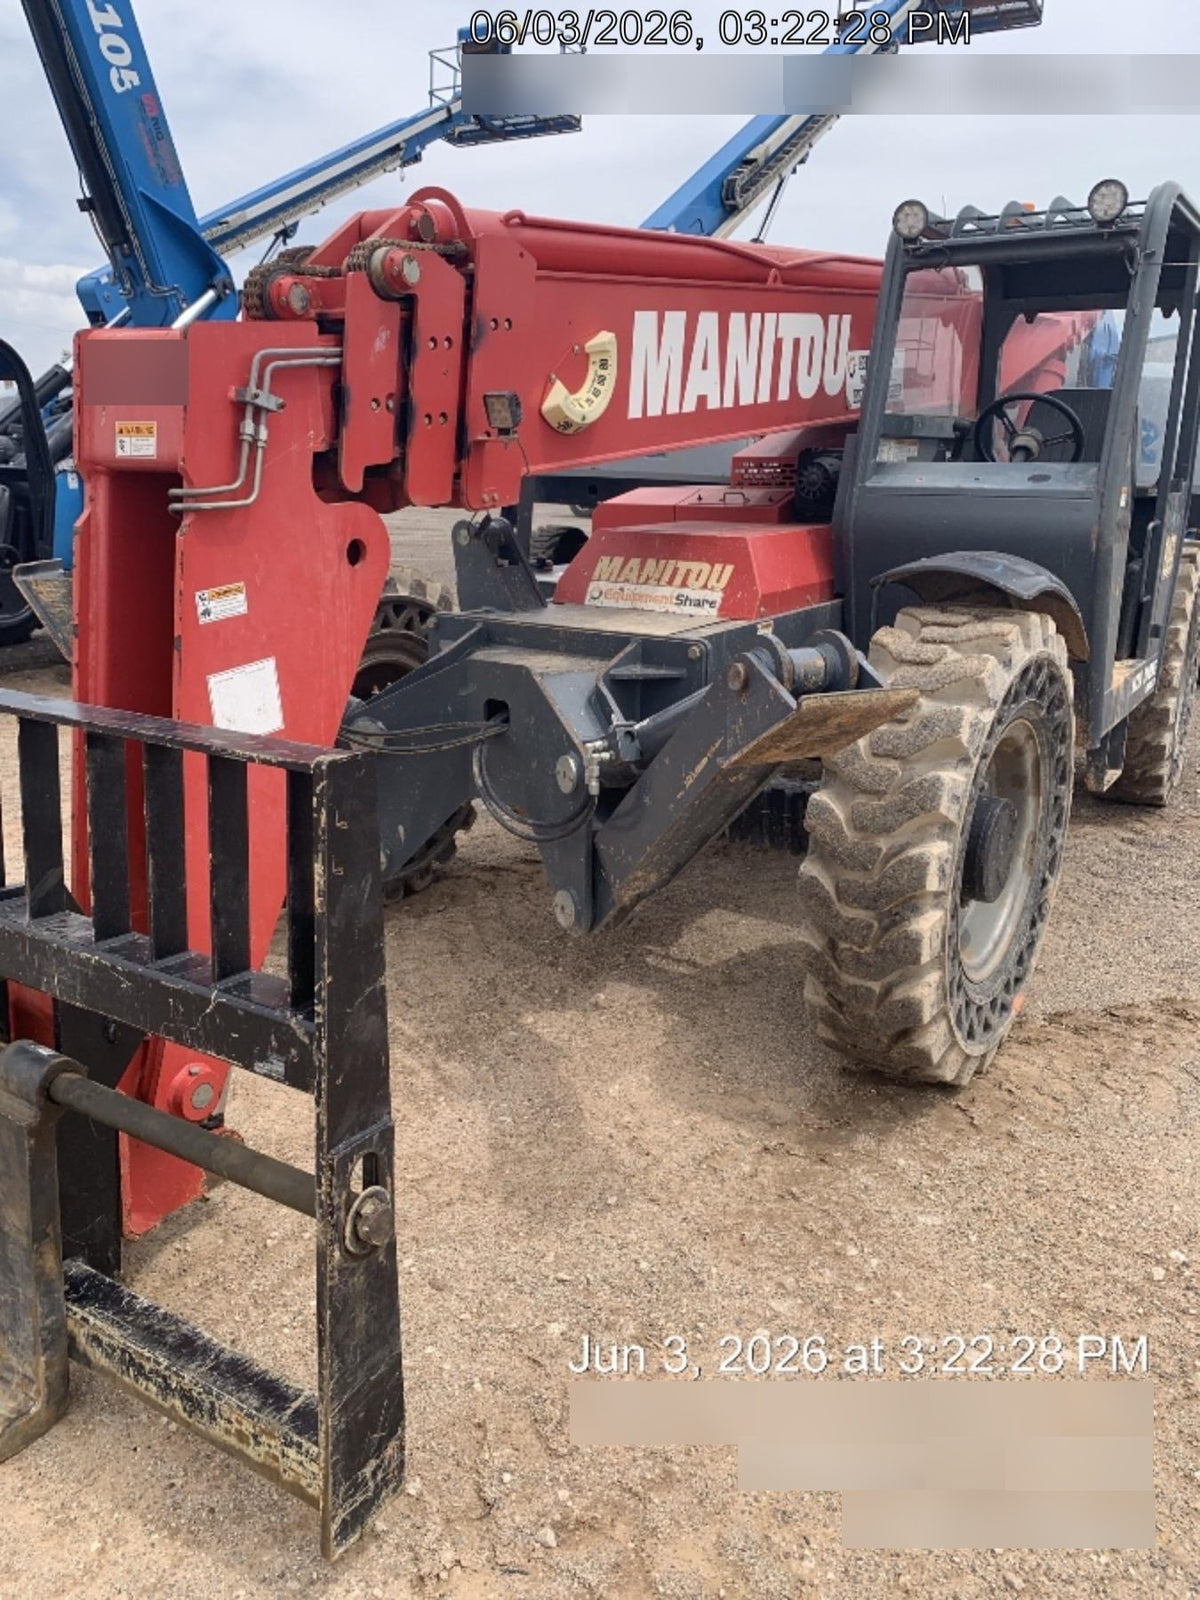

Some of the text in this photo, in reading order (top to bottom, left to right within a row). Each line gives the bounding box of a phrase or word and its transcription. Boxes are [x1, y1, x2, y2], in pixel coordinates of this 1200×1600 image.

[627, 310, 852, 420] MANITOU
[591, 555, 735, 591] MANITOU
[604, 587, 717, 608] EquipmentShare
